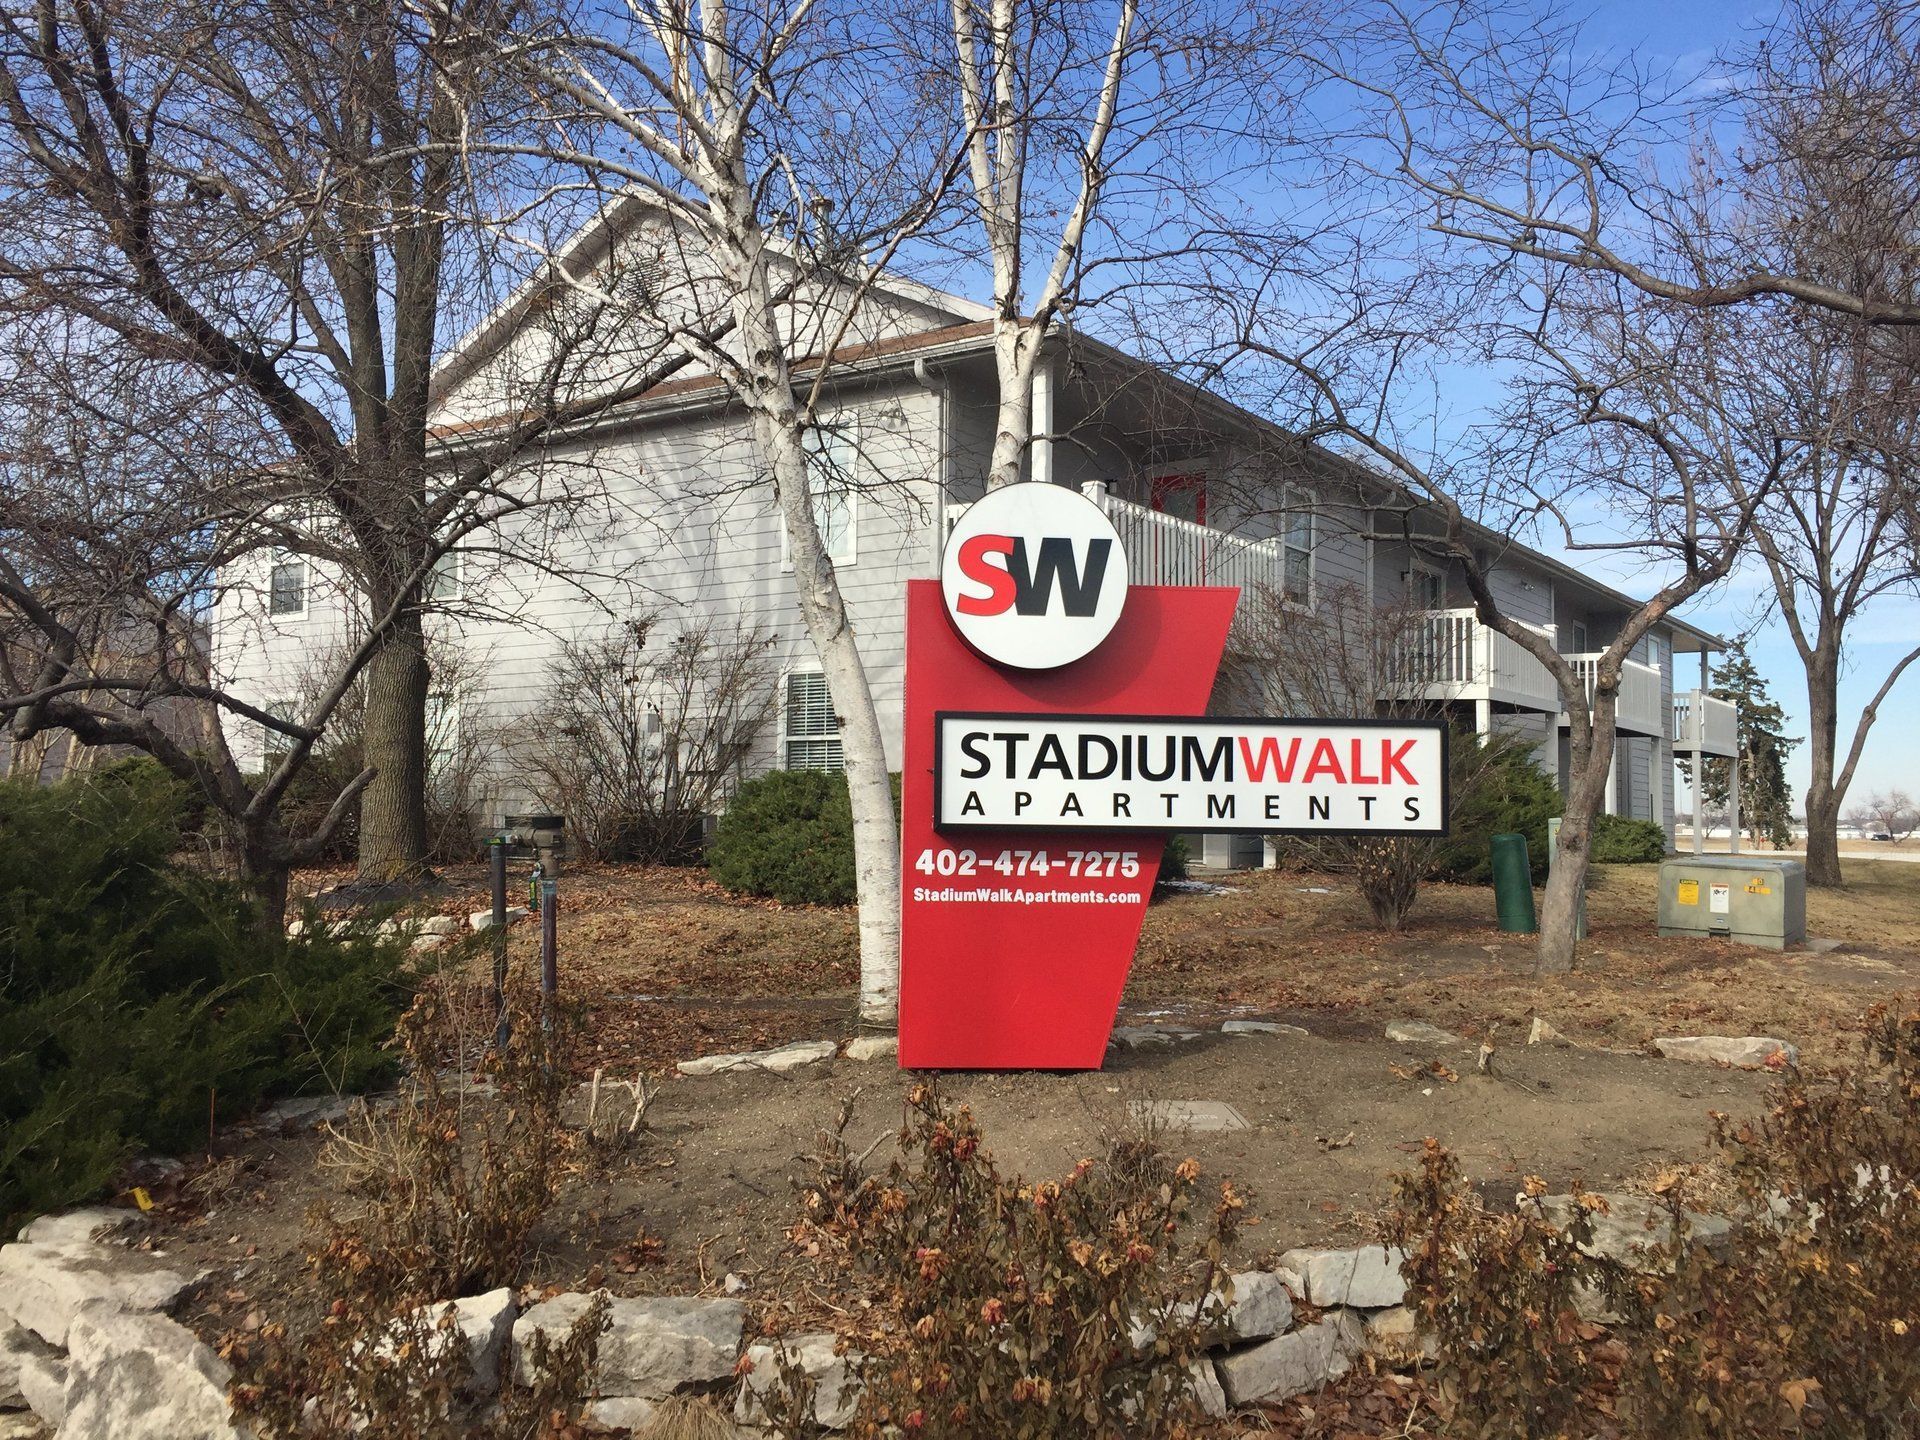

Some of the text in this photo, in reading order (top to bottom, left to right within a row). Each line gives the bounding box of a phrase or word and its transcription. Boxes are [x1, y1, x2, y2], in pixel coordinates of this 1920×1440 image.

[956, 533, 1113, 617] SW
[960, 732, 1420, 785] STADIUMWALK
[961, 790, 1420, 822] APARTMENTS
[915, 849, 1140, 878] 402-474-7275
[913, 887, 1141, 905] StadiumWalkApartments.com
